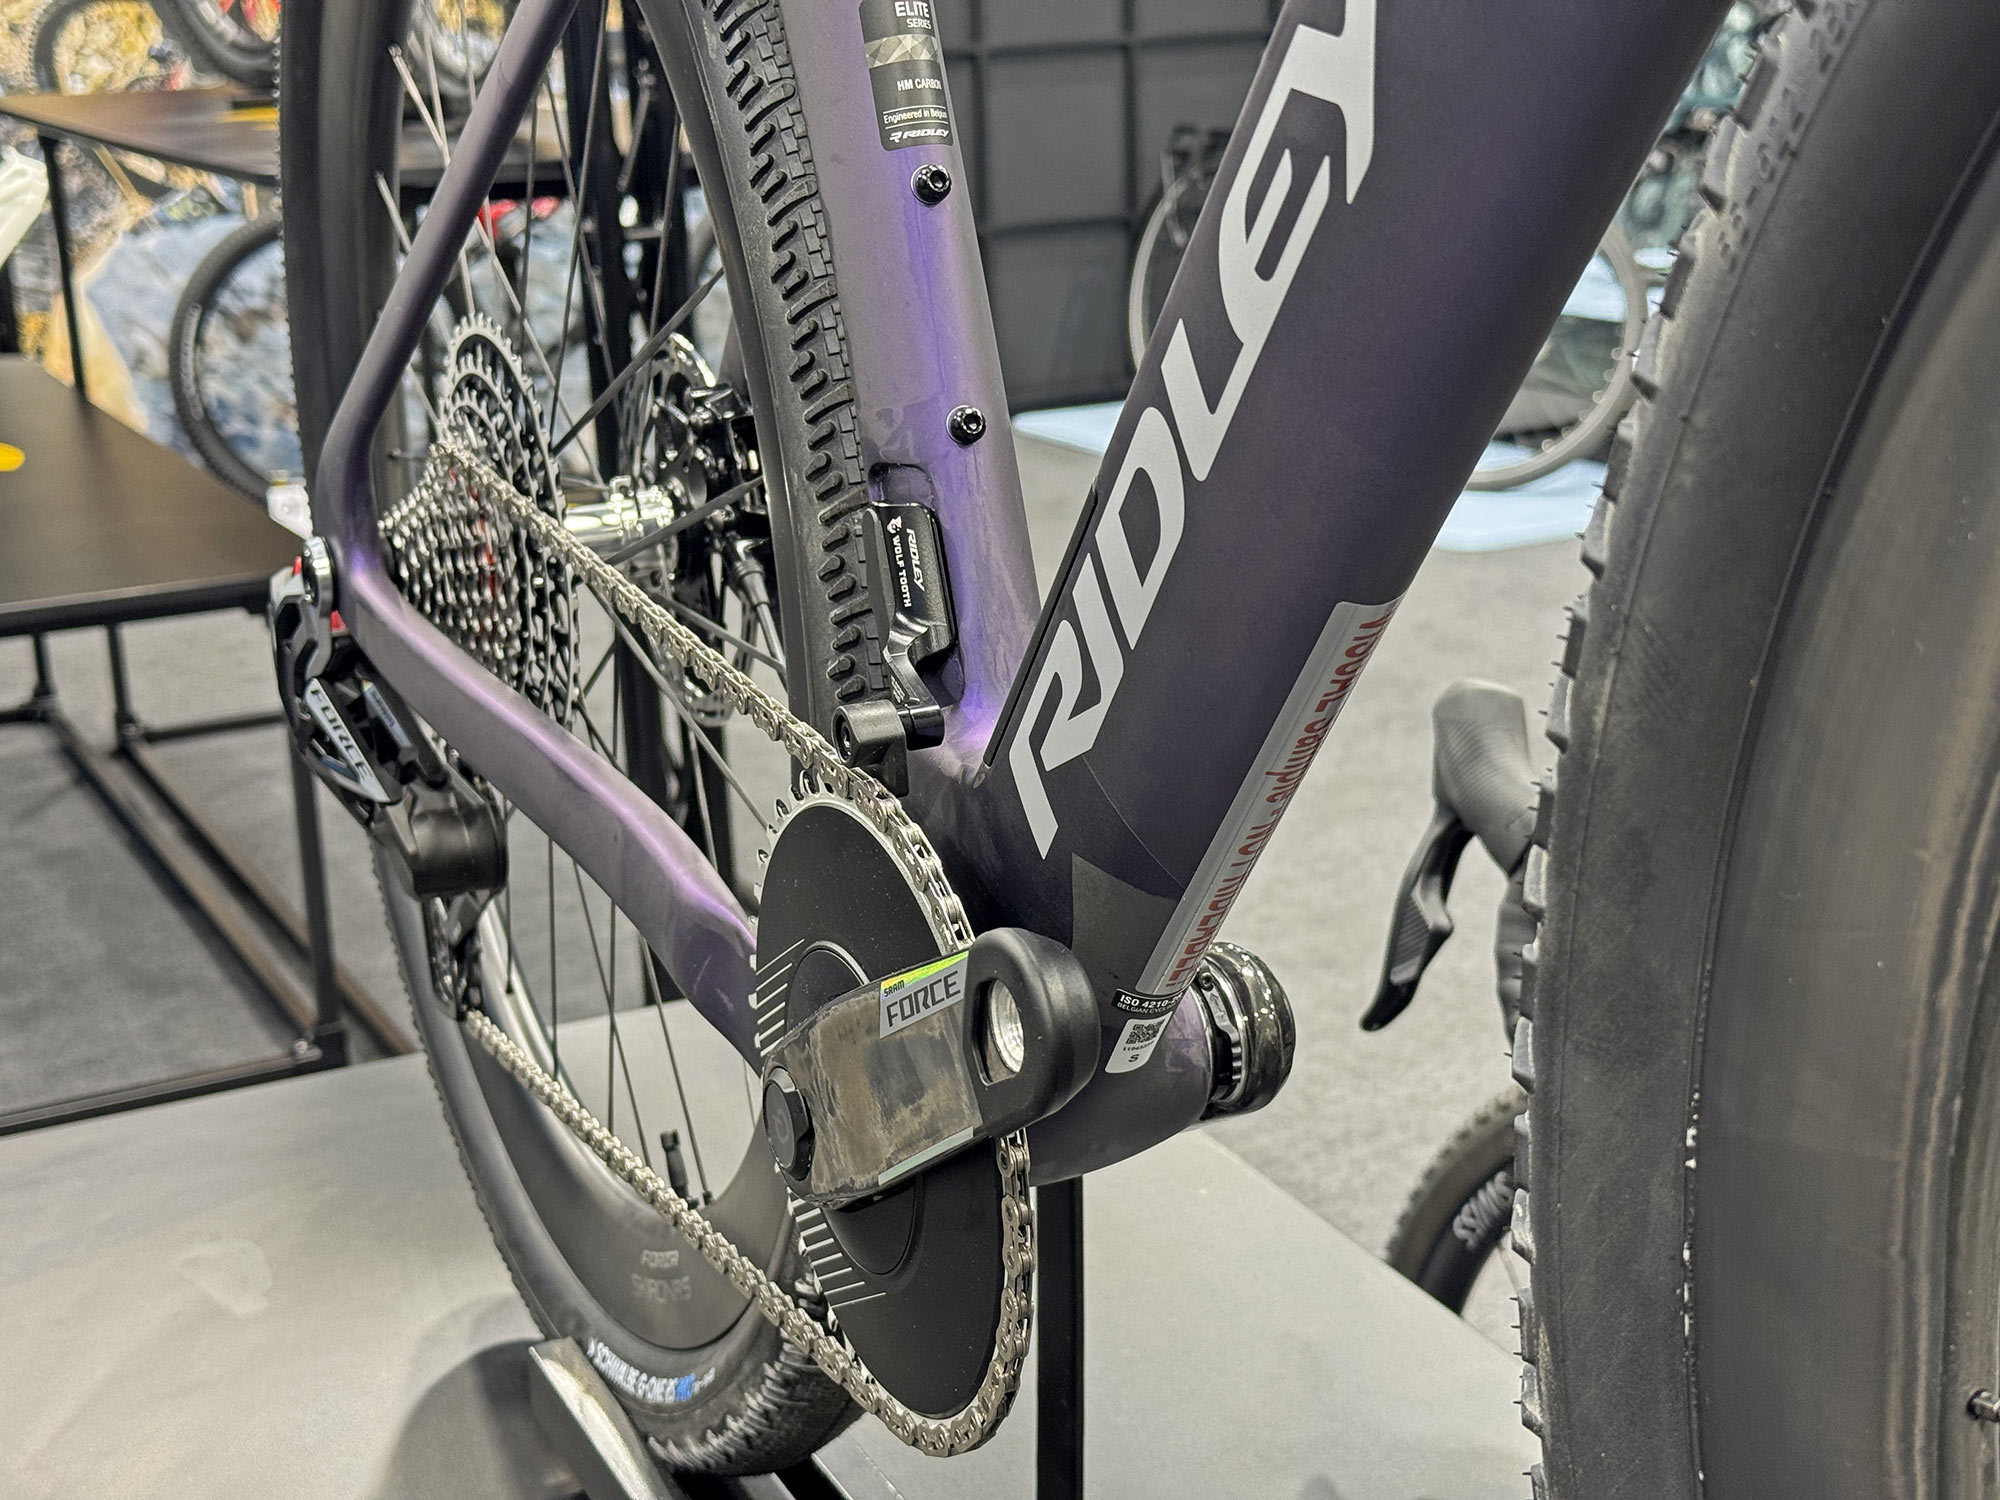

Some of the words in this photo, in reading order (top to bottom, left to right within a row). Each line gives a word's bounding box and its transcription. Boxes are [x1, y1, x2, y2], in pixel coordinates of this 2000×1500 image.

[894, 1, 930, 18] ELITE
[906, 18, 932, 30] SERIES
[896, 79, 913, 91] HM
[883, 109, 923, 124] Engineered
[923, 108, 930, 118] in
[902, 128, 949, 140] RIDLEY
[892, 535, 905, 569] WOLF
[906, 528, 925, 592] RIDLEY
[898, 569, 912, 607] TOOTH
[310, 688, 370, 781] FORCE
[883, 979, 905, 998] SRAM
[886, 970, 961, 1028] FORCE
[1120, 994, 1140, 1007] ISO
[1117, 1002, 1149, 1014] BELGIAN
[1128, 1053, 1140, 1063] S
[593, 1341, 640, 1397] SCHWALBE
